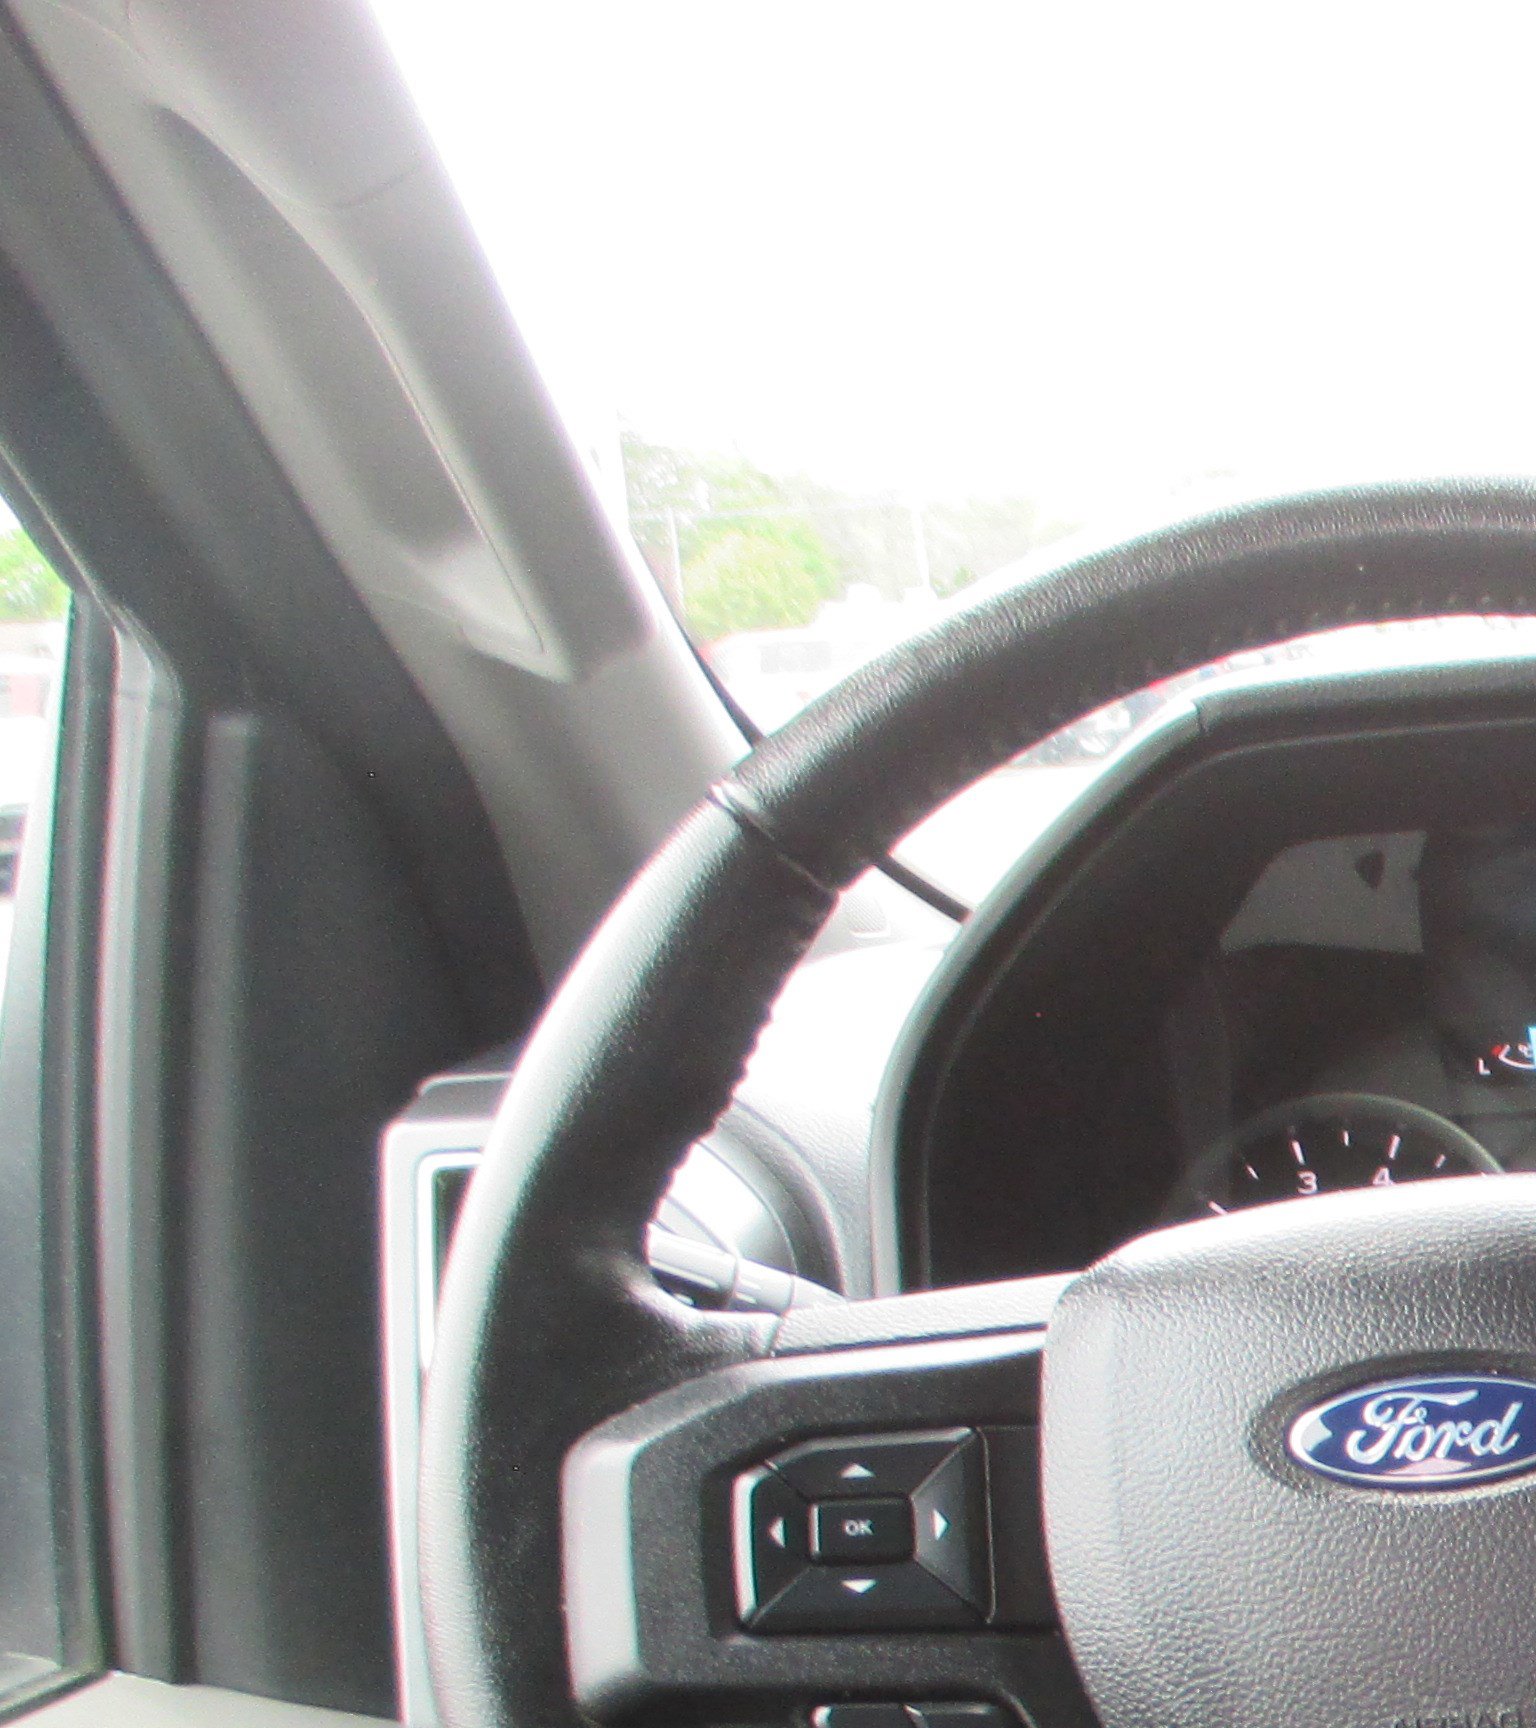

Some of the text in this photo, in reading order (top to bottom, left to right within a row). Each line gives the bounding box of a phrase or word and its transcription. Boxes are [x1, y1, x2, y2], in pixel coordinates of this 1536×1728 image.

[1478, 1058, 1492, 1075] L
[1296, 1170, 1318, 1196] 3
[1344, 1387, 1522, 1465] Ford
[844, 1518, 874, 1537] OK
